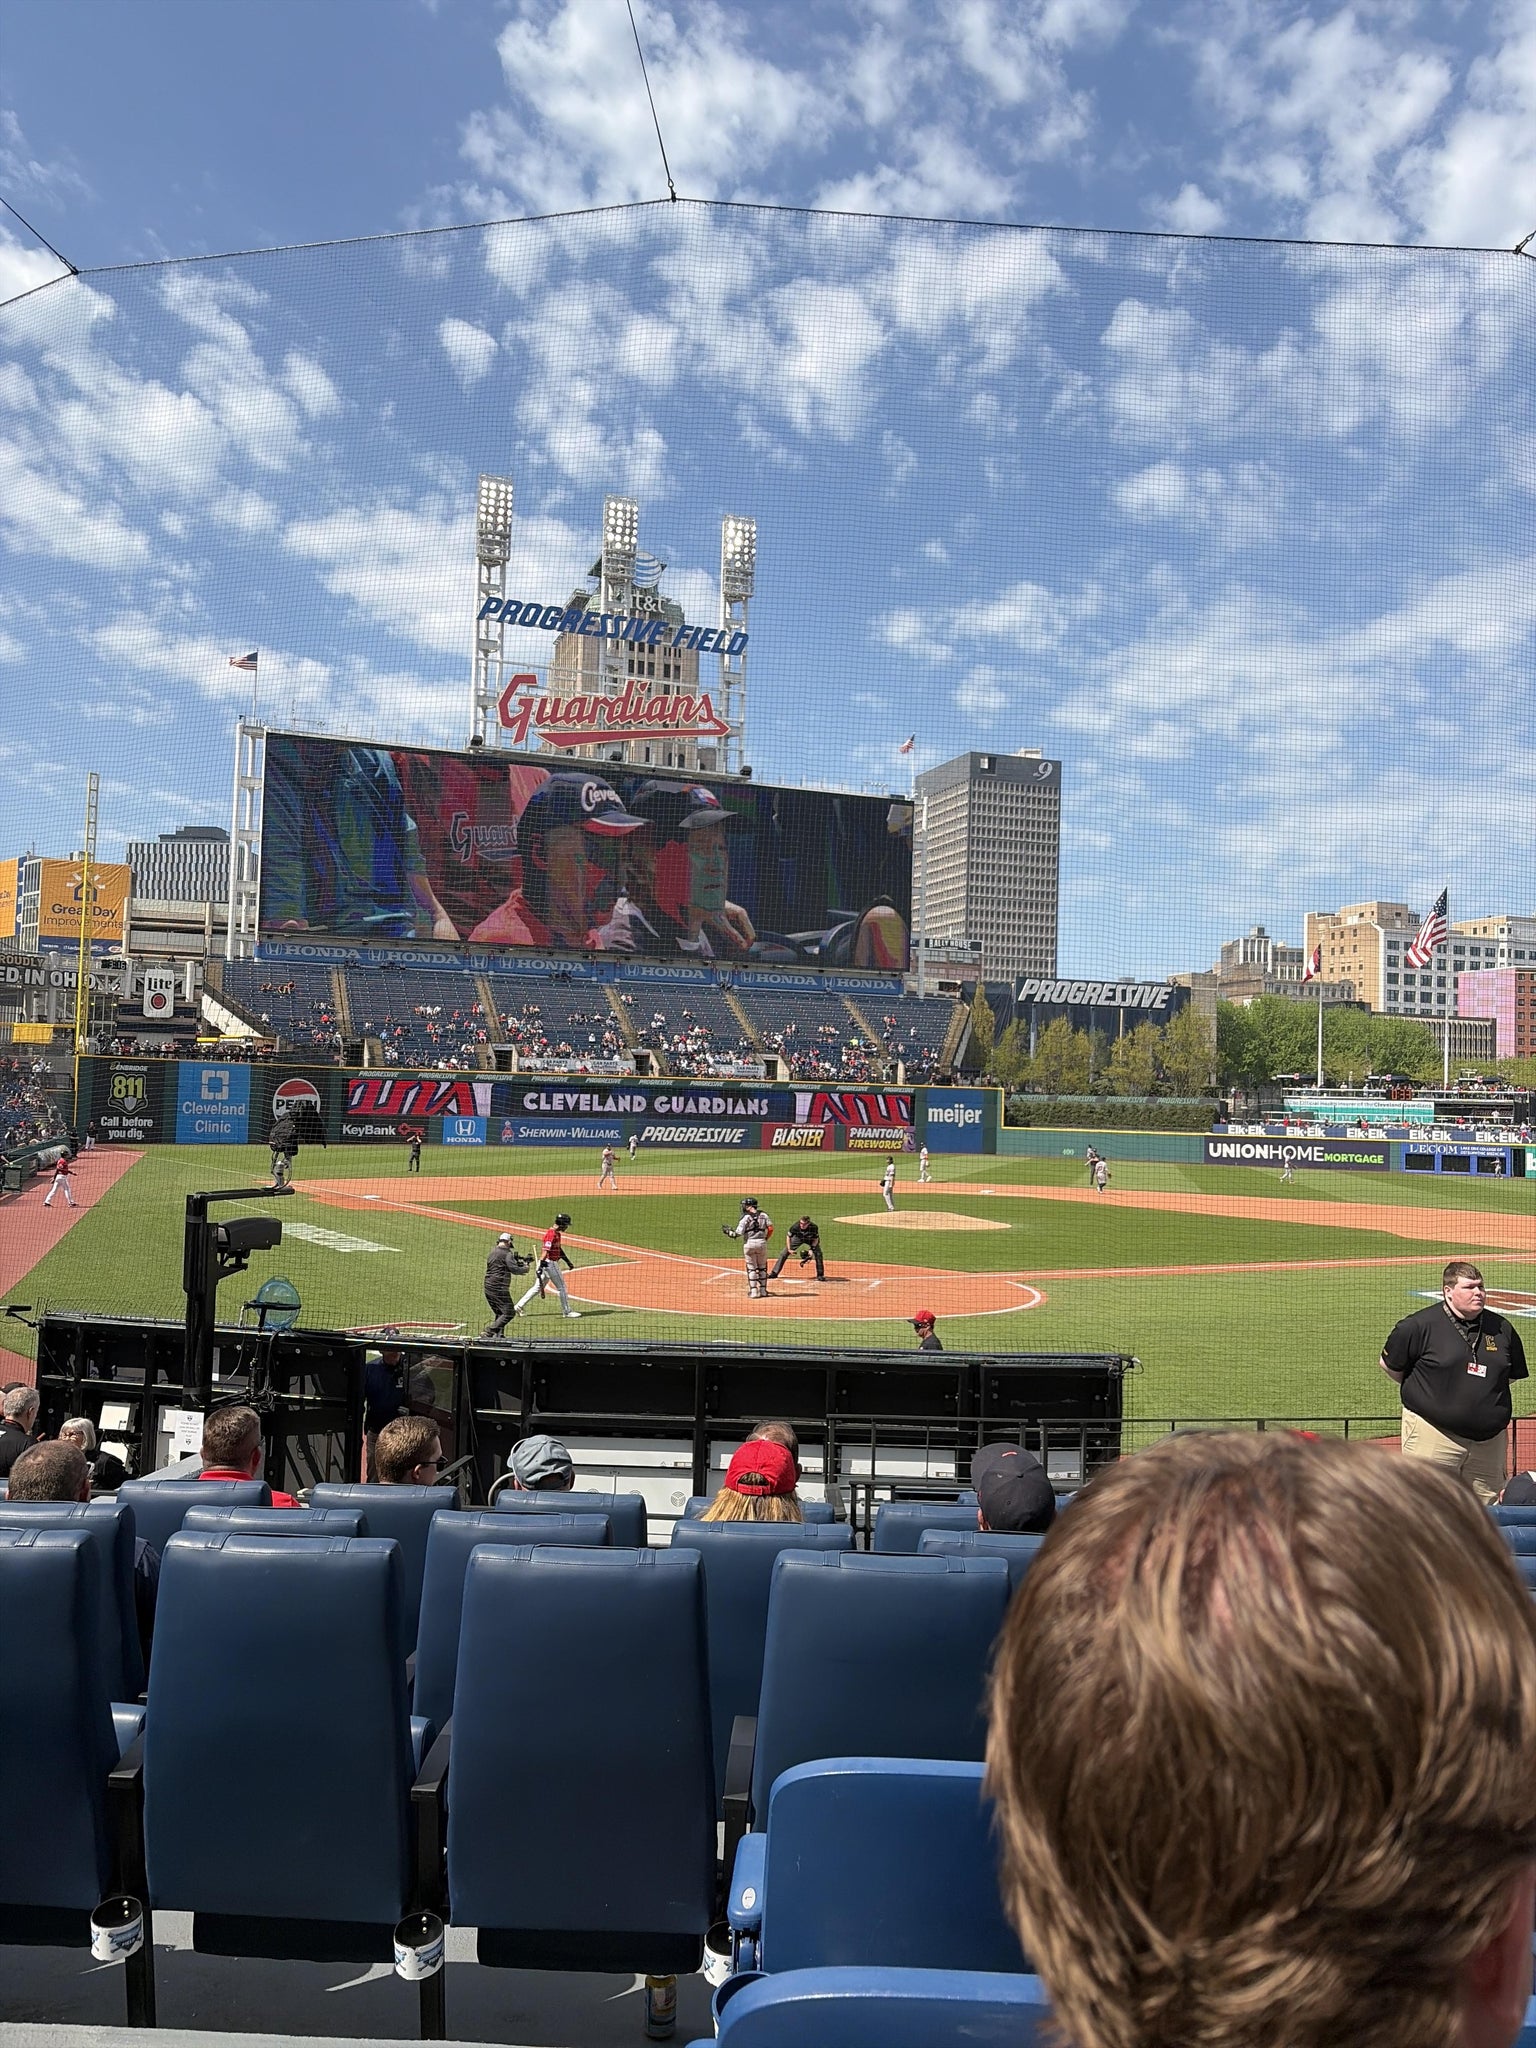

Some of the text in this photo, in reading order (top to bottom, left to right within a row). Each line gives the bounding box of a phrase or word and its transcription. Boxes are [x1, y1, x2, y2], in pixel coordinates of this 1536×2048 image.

[477, 597, 749, 656] PROGRESSIVE FIELD
[497, 673, 730, 748] Guardians
[51, 903, 117, 919] Great Day
[282, 944, 362, 959] HONDA
[386, 950, 461, 965] HONDA
[517, 958, 586, 972] HONDA
[641, 966, 706, 979] HONDA
[24, 968, 46, 986] IN
[50, 971, 97, 990] OHO
[147, 977, 172, 991] Lite
[755, 973, 817, 986] HONDA
[837, 978, 896, 990] HONDA
[1018, 978, 1173, 1009] PROGRESSIVE
[113, 1075, 143, 1098] 811
[182, 1101, 245, 1115] Cleveland
[523, 1092, 768, 1116] CLEVELAND GUARDIANS
[101, 1116, 153, 1127] Call before
[928, 1104, 982, 1128] meijer
[108, 1128, 145, 1140] you dig.
[195, 1119, 231, 1134] Clinic
[342, 1124, 396, 1137] KeyBank
[849, 1127, 904, 1139] PHANTOM
[641, 1126, 745, 1144] PROGRESSIVE
[771, 1128, 824, 1147] BLASTER
[848, 1139, 903, 1150] FIREWORKS
[1324, 1152, 1384, 1165] MORTGAGE
